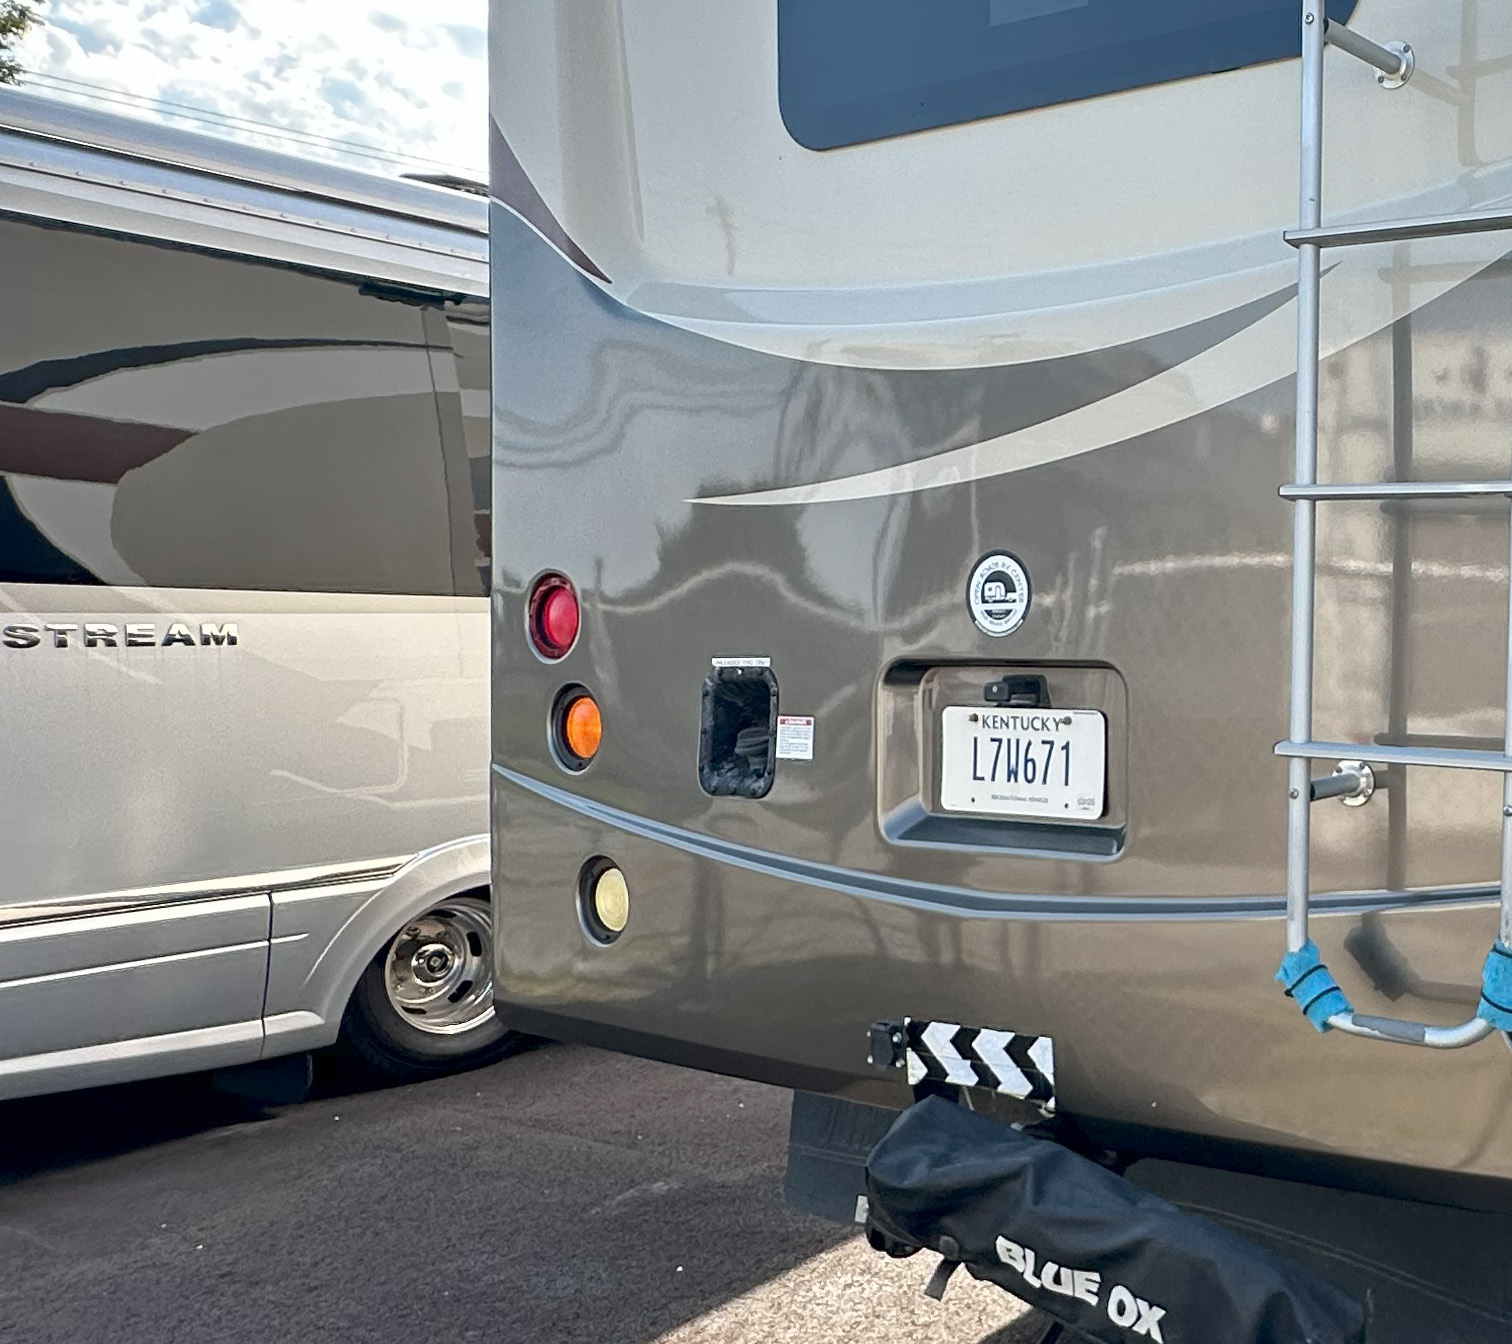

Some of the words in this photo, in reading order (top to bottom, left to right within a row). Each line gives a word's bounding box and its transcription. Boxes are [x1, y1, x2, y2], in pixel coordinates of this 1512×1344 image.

[2, 622, 239, 649] STREAM
[981, 714, 1062, 732] KENTUCKY
[971, 735, 1071, 787] L7W671
[995, 1234, 1102, 1307] BLUE
